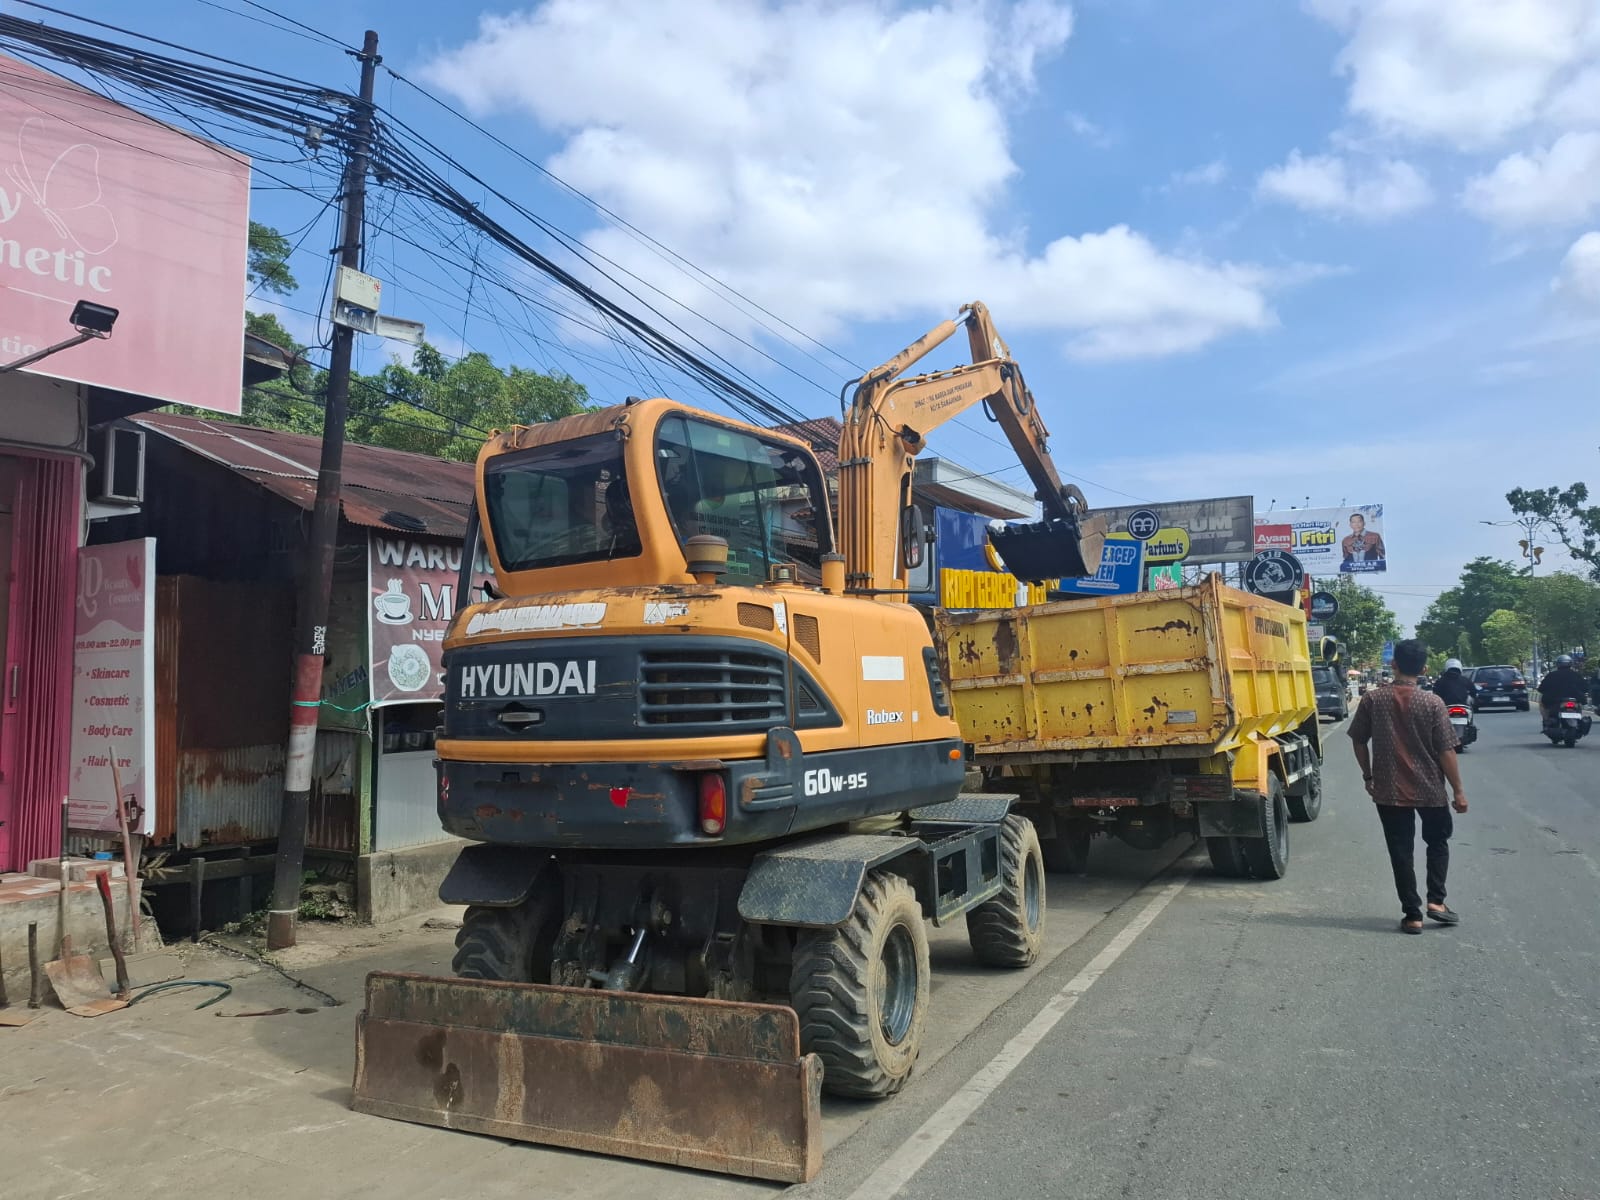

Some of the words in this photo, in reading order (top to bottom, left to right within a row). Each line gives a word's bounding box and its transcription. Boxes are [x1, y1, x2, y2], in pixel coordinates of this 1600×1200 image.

[1257, 534, 1290, 544] Ayam
[1301, 528, 1336, 545] Fitri
[1101, 547, 1135, 564] ERCEP
[941, 568, 975, 608] KOPI
[90, 668, 130, 679] Skincare
[461, 660, 597, 697] HYUNDAI
[89, 693, 129, 706] Cosmetic
[866, 709, 904, 725] Robex
[88, 724, 110, 738] Body
[112, 725, 133, 736] Care
[88, 755, 108, 767] Hair
